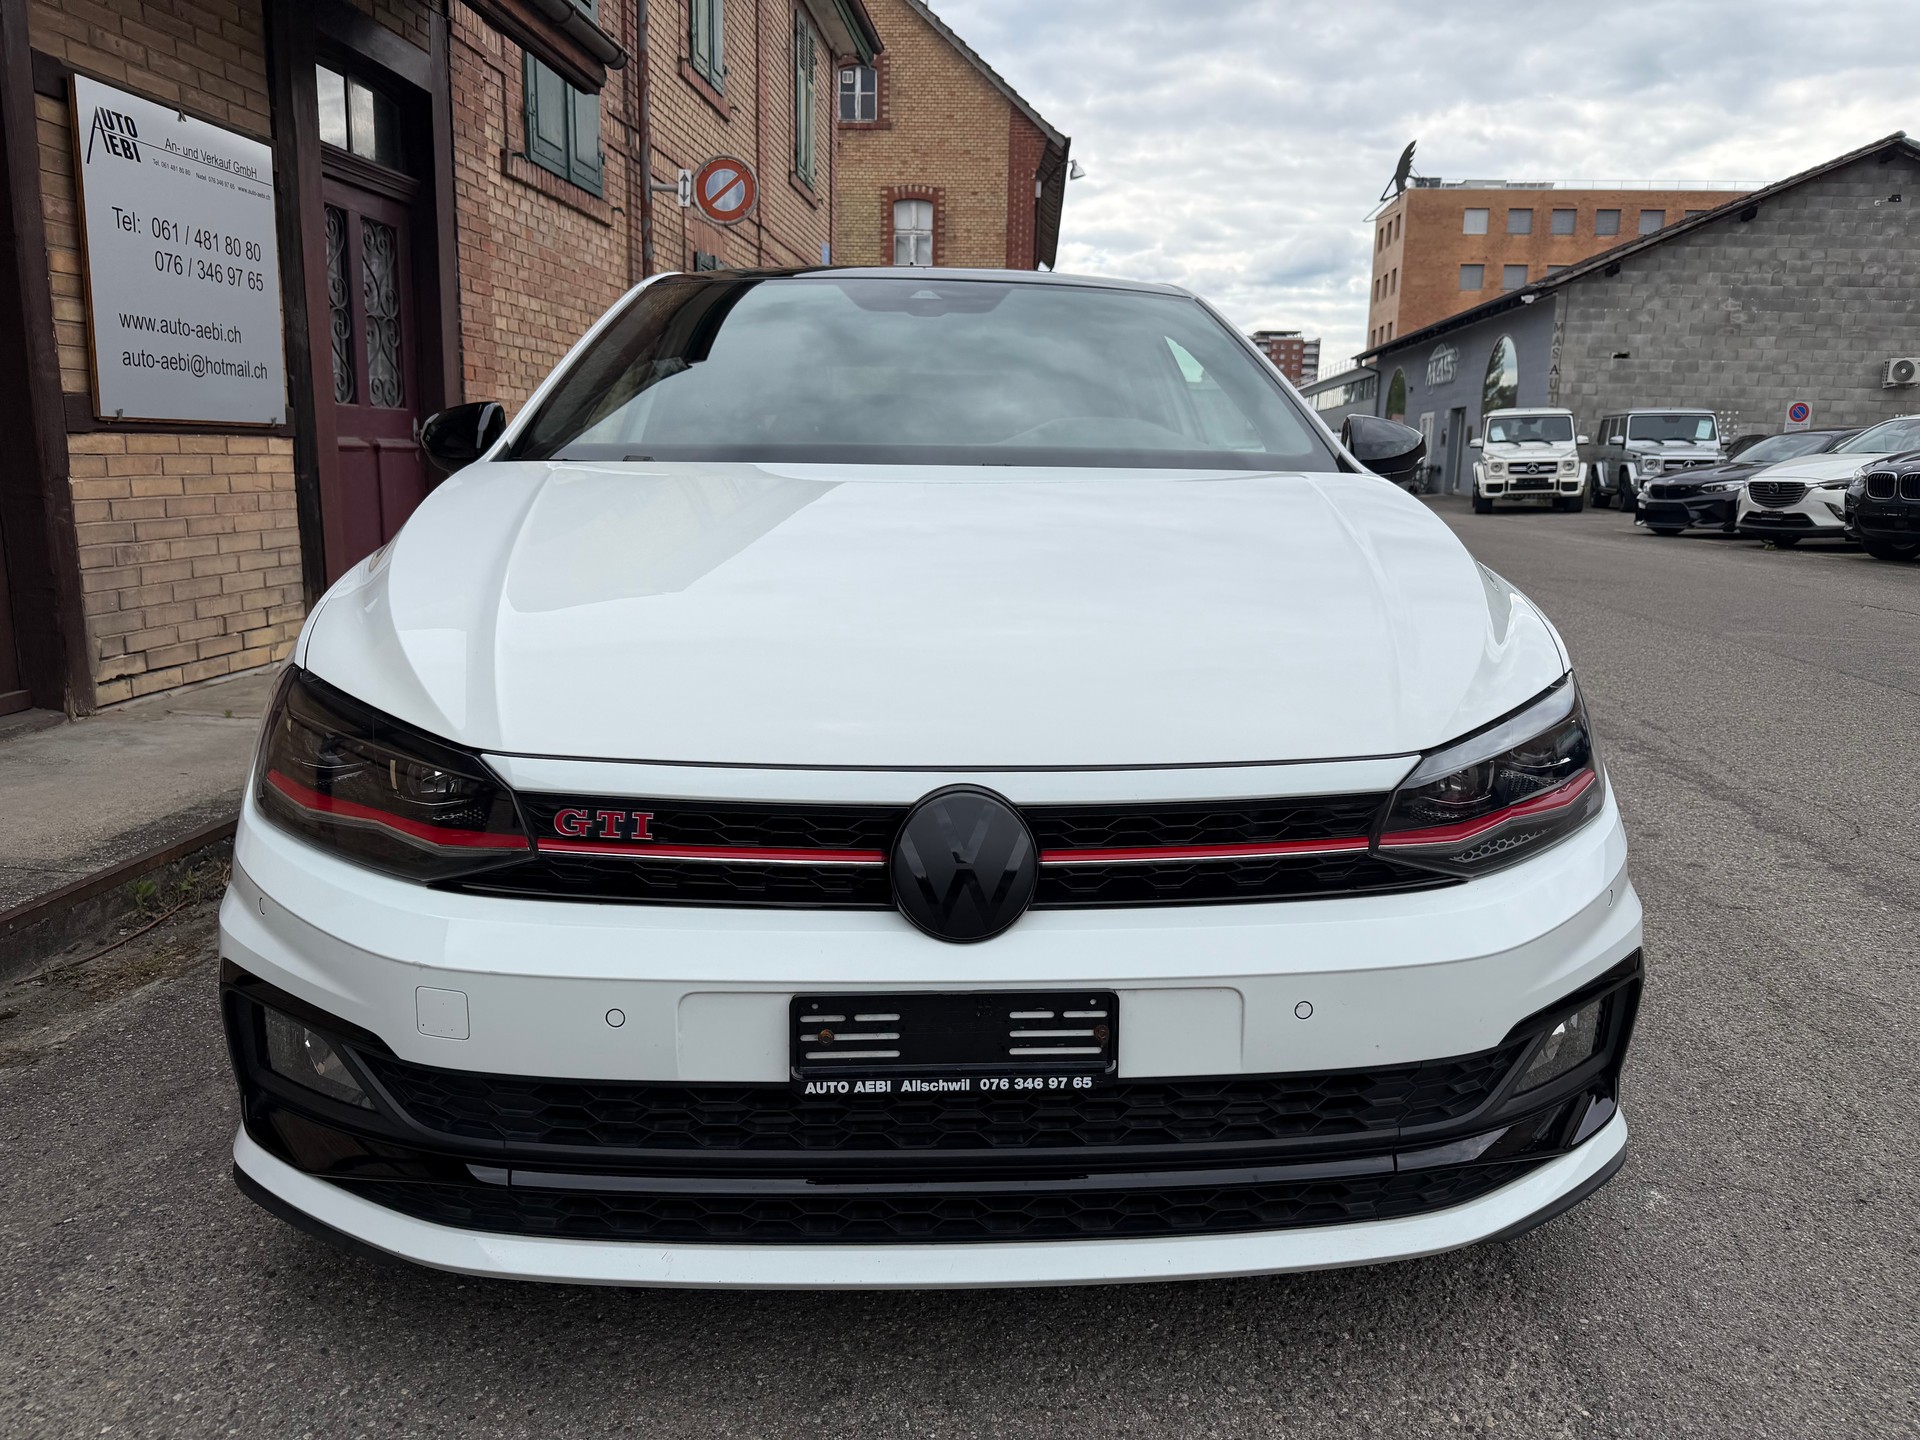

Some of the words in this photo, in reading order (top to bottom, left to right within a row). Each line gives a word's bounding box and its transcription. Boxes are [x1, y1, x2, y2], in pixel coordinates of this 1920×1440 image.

[161, 161, 169, 170] 061
[165, 138, 181, 152] An-
[182, 146, 199, 160] und
[200, 149, 232, 171] Verkauf
[233, 160, 258, 179] GmbH
[111, 206, 141, 234] Tel:
[151, 217, 179, 243] 061
[185, 225, 190, 246] /
[194, 228, 219, 252] 481
[225, 235, 241, 258] 80
[245, 241, 261, 262] 80
[154, 250, 184, 276] 076
[188, 257, 193, 277] /
[197, 259, 223, 284] 346
[227, 266, 244, 287] 97
[247, 271, 264, 292] 65
[118, 312, 242, 344] www.auto-aebi.ch
[122, 349, 268, 380] auto-aebi@hotmail.ch
[553, 808, 655, 841] GTI
[805, 1081, 850, 1095] AUTO
[853, 1080, 891, 1093] AEBI
[900, 1079, 970, 1092] Allschwil
[979, 1078, 1010, 1091] 076
[1014, 1077, 1044, 1090] 346
[1048, 1077, 1068, 1090] 97
[1072, 1076, 1093, 1089] 65
